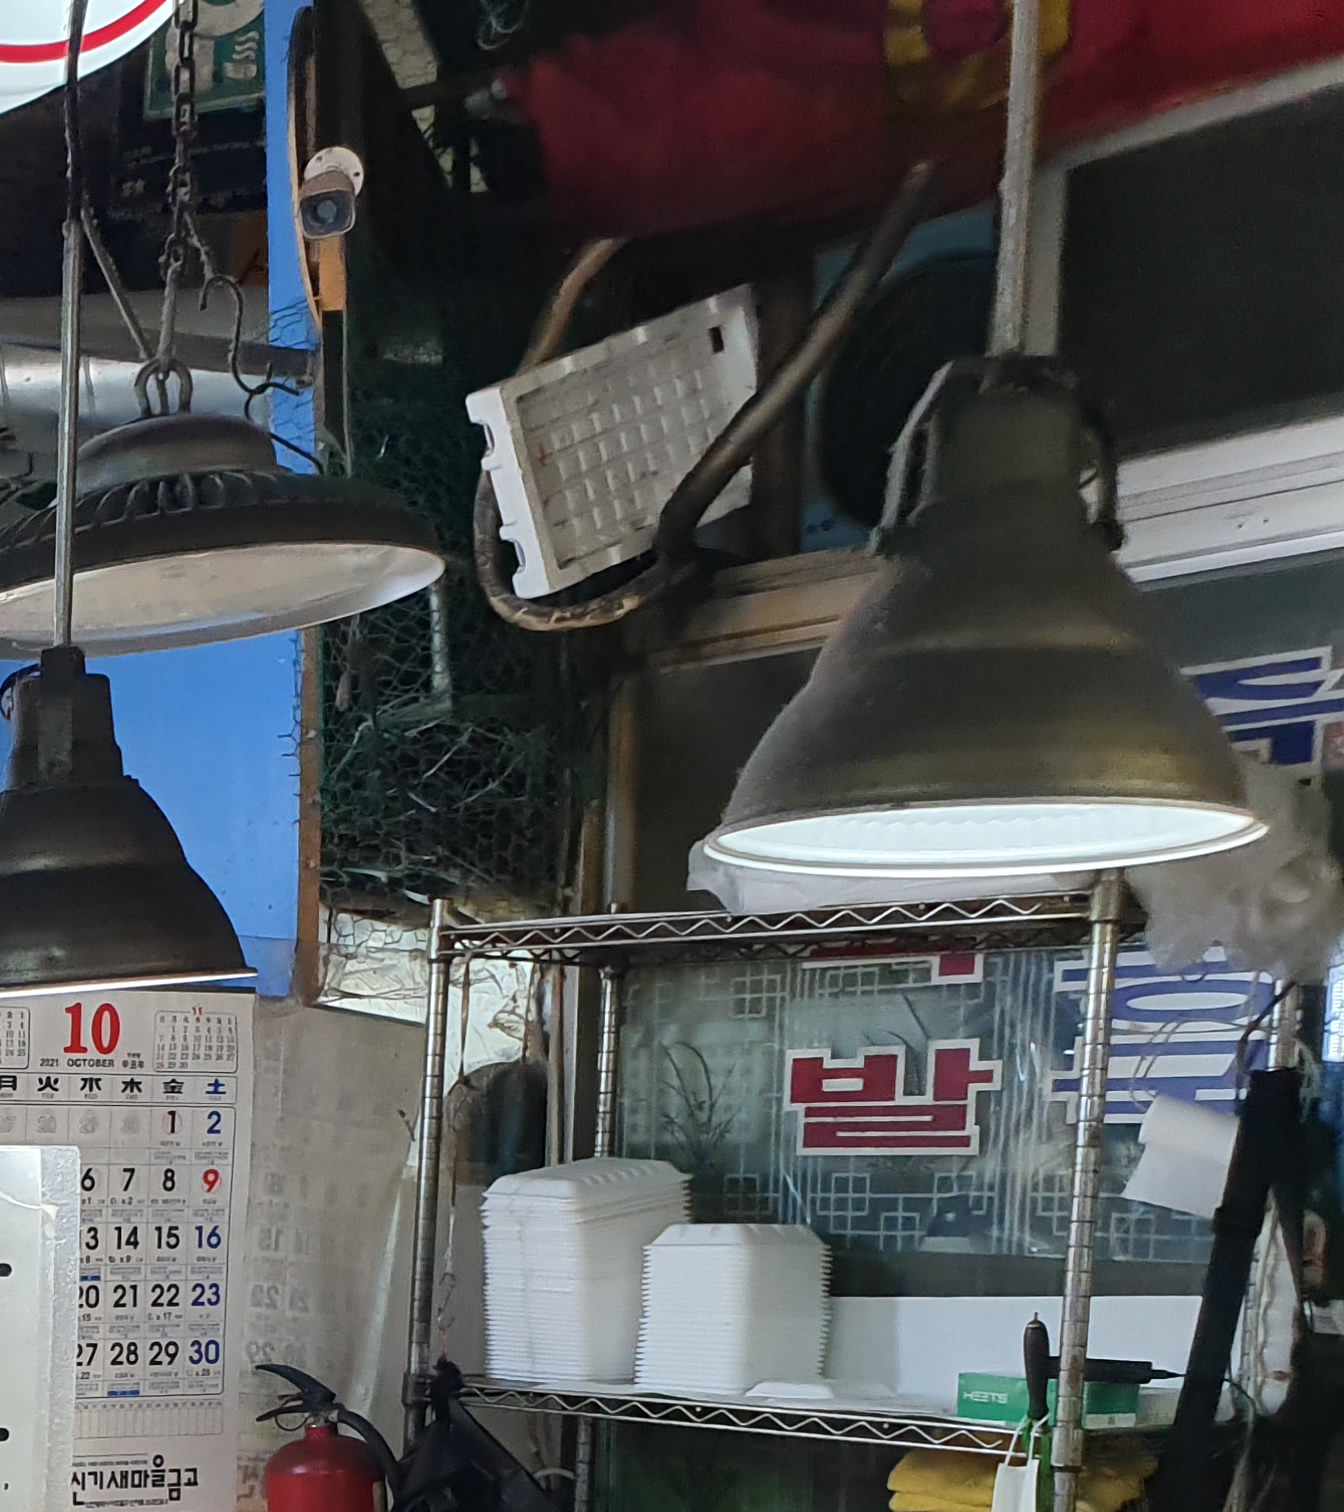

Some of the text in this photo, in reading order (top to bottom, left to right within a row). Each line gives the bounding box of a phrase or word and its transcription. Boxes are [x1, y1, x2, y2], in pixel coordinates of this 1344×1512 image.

[63, 1001, 121, 1055] 10
[66, 1058, 115, 1068] OCTOBER
[37, 1076, 60, 1092] 火
[79, 1077, 103, 1092] 水
[121, 1078, 143, 1094] 木
[162, 1079, 185, 1095] 金
[204, 1079, 227, 1095] 土
[783, 1038, 1002, 1156] 발
[166, 1110, 176, 1135] 1
[205, 1110, 222, 1135] 2
[80, 1167, 220, 1193] 6 7 8 9
[113, 1225, 140, 1250] 14
[154, 1225, 180, 1250] 15
[194, 1224, 222, 1249] 16
[112, 1284, 139, 1308] 21
[151, 1283, 180, 1308] 22
[191, 1283, 221, 1307] 23
[109, 1341, 139, 1366] 28
[148, 1341, 180, 1366] 29
[188, 1339, 220, 1365] 30
[70, 1454, 200, 1506] 신기새마을금고
